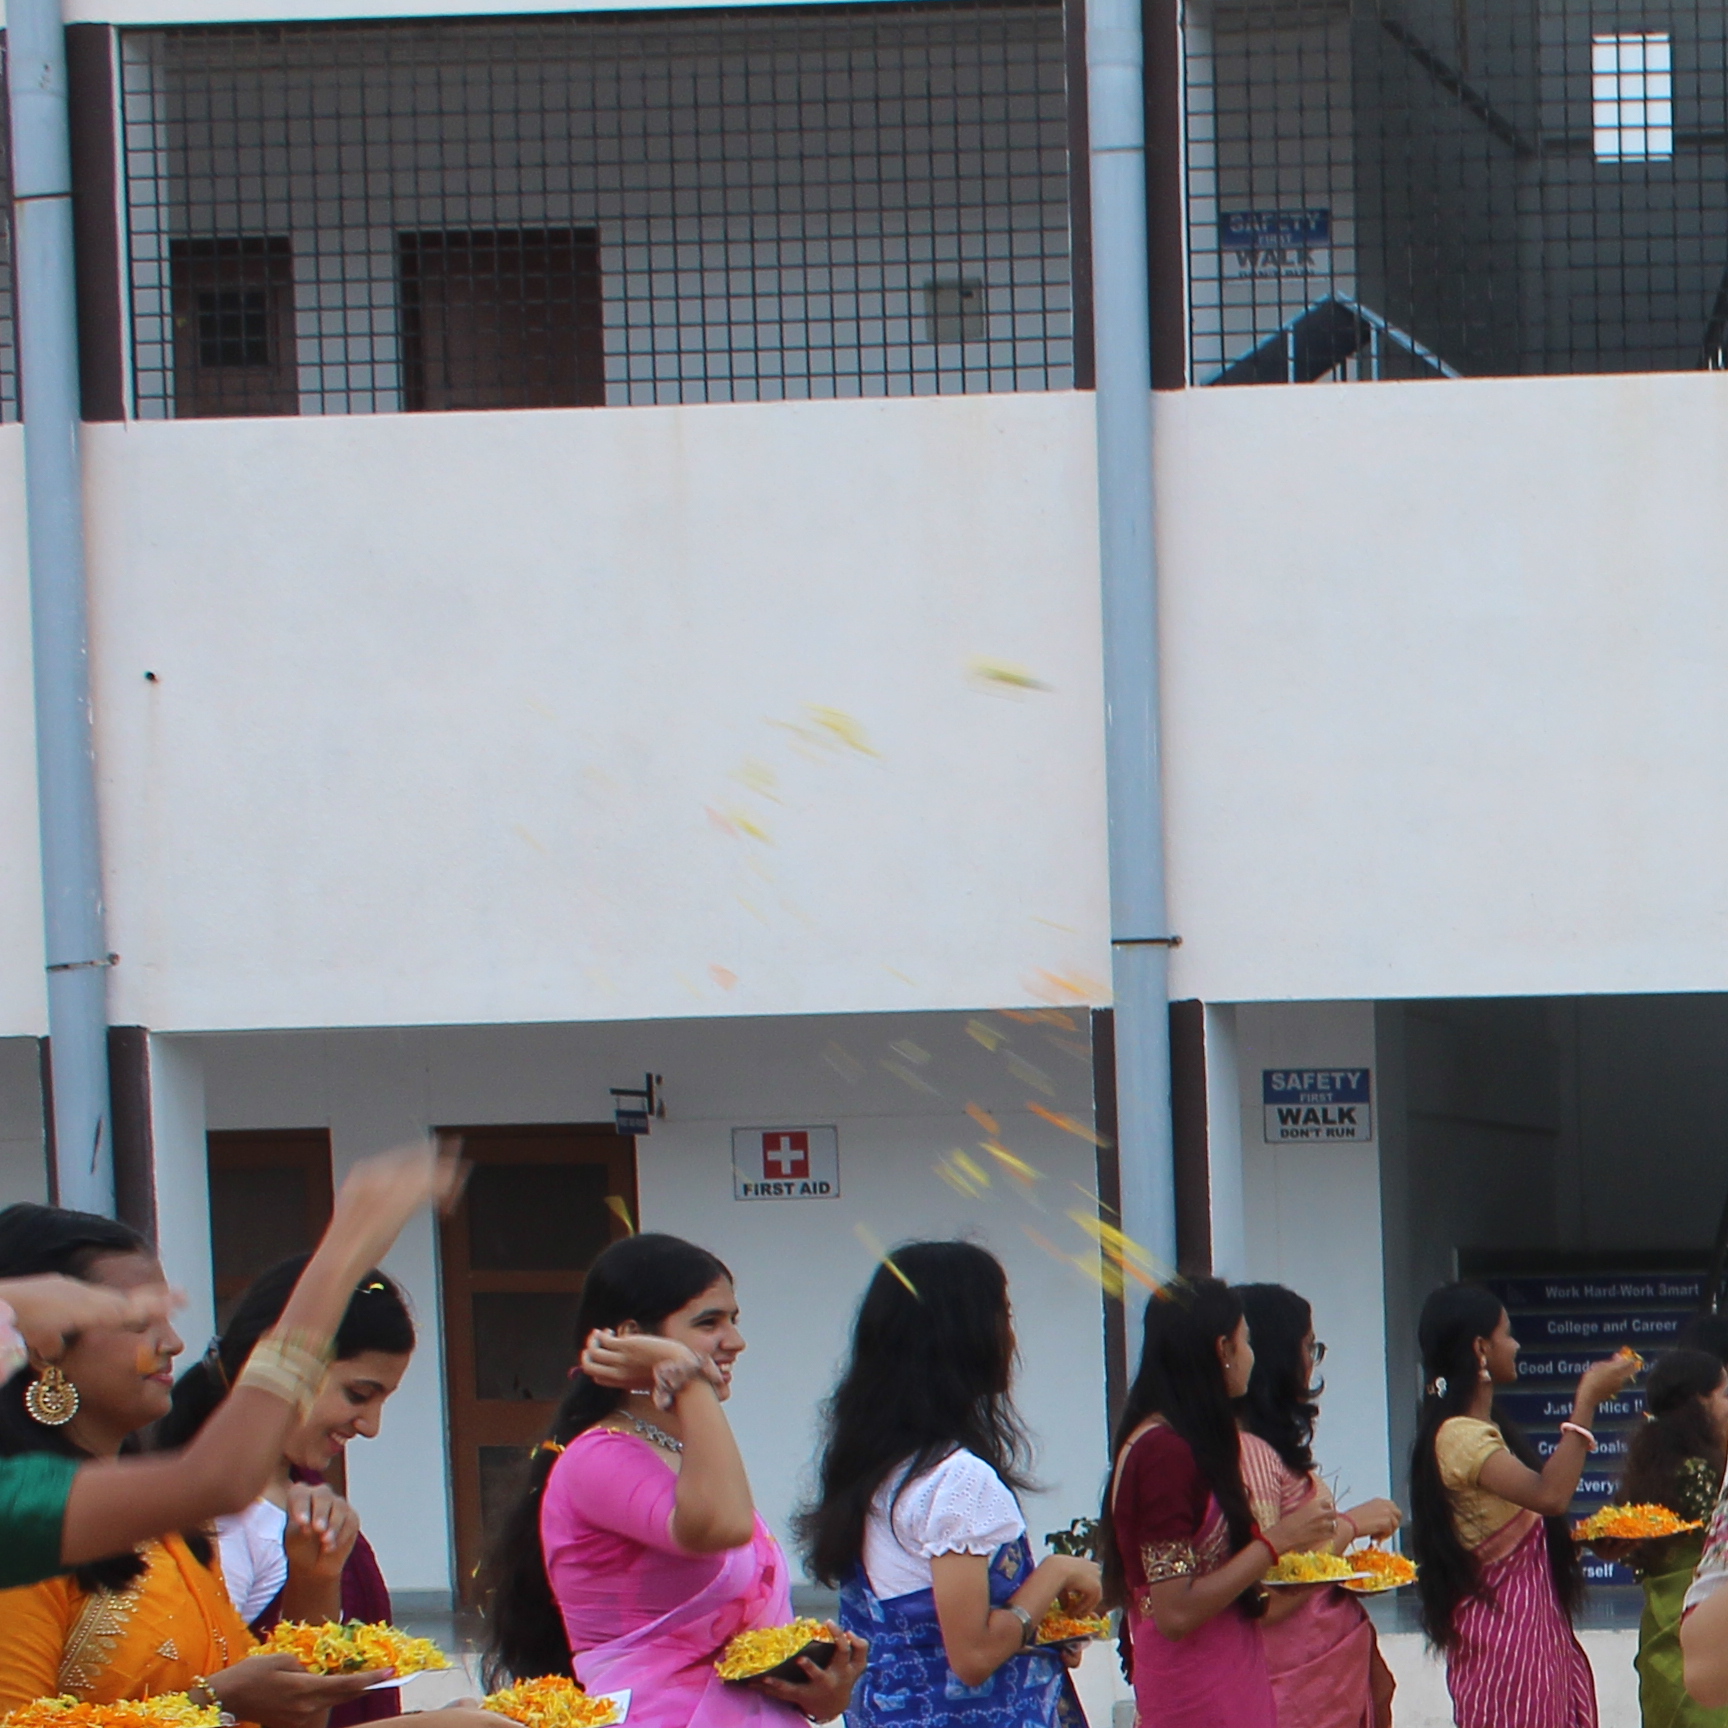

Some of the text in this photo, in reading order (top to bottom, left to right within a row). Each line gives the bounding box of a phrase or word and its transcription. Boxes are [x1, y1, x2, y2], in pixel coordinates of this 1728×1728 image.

[1235, 248, 1315, 267] WALK
[1271, 1071, 1361, 1091] SAFETY
[1299, 1092, 1334, 1102] FIRST
[1277, 1106, 1357, 1126] WALK
[1280, 1127, 1356, 1138] DON'T RUN
[743, 1181, 831, 1196] FIRST AID
[1545, 1285, 1580, 1299] Work
[1547, 1319, 1678, 1336] College and Career
[1518, 1360, 1592, 1375] Good Grad
[1598, 1400, 1630, 1414] Nice
[1576, 1477, 1620, 1495] Every
